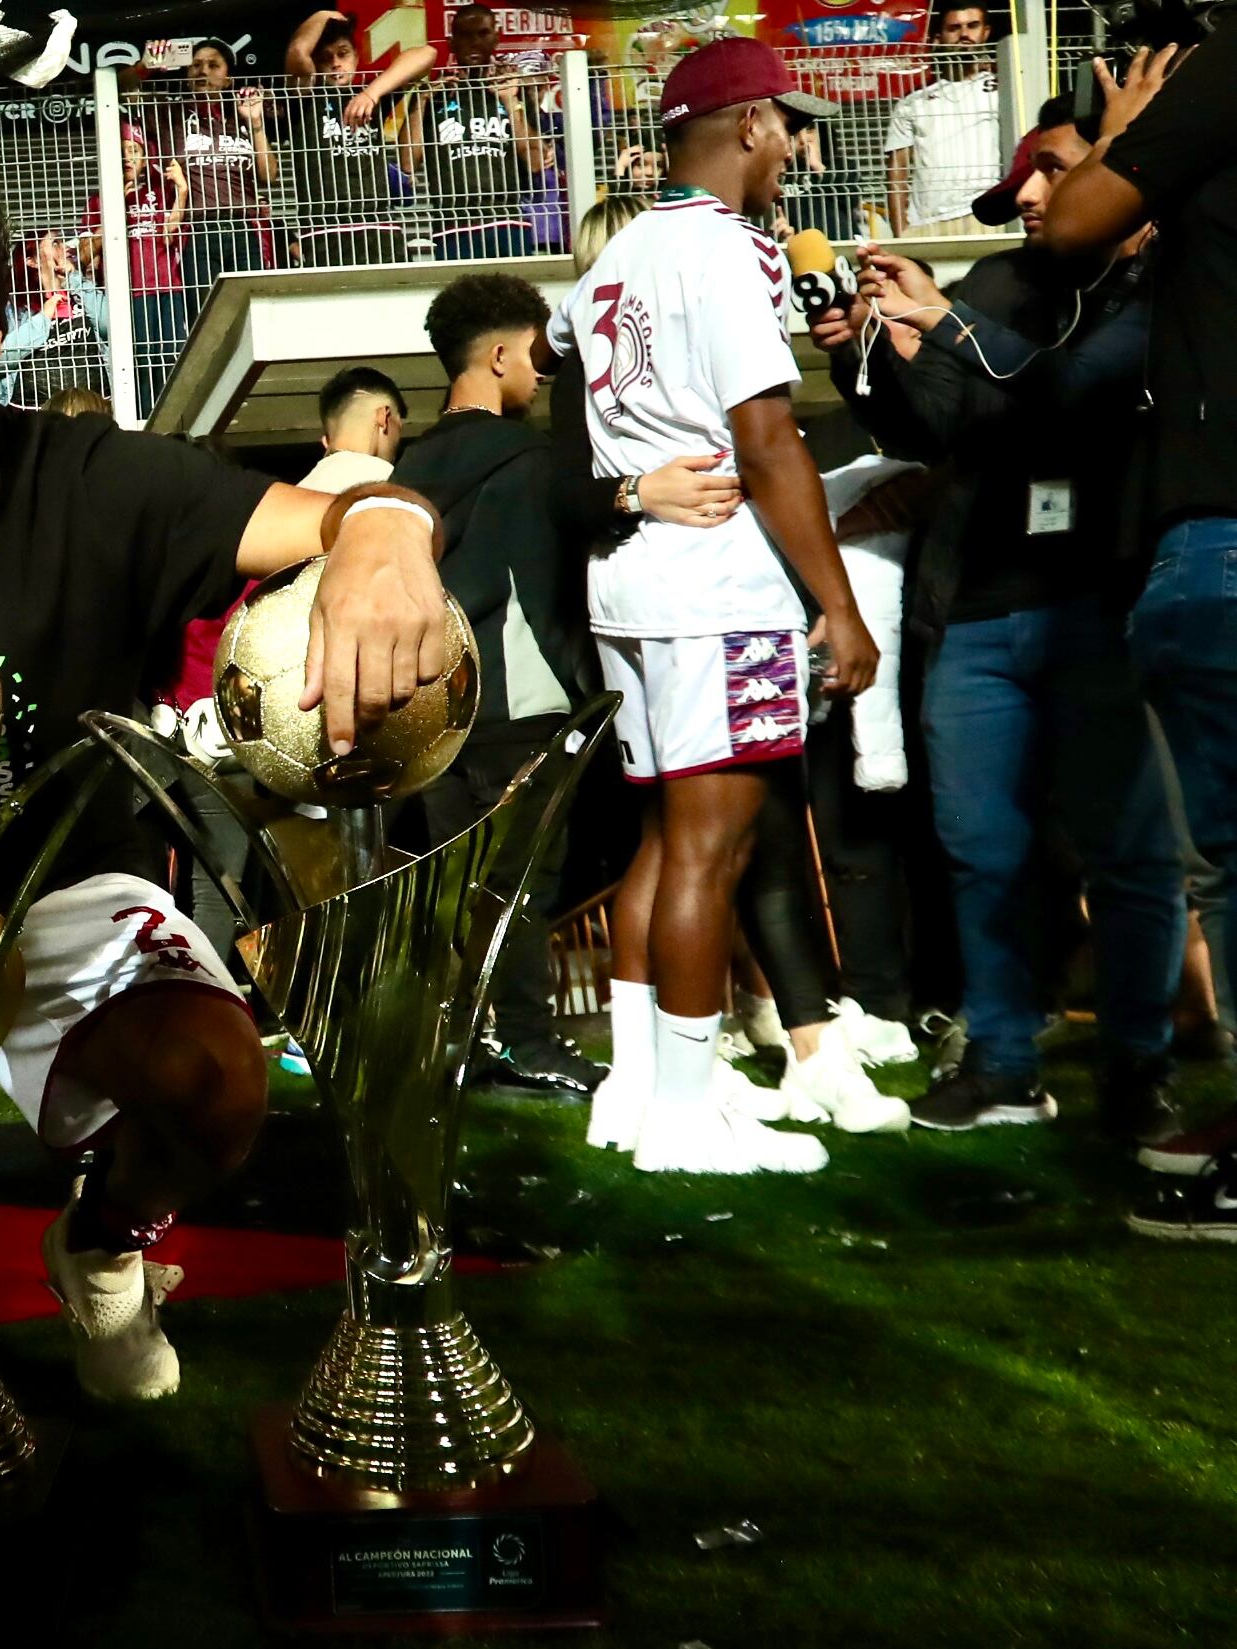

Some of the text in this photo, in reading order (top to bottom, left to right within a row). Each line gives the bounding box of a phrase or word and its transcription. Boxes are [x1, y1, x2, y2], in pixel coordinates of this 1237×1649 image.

[338, 1548, 474, 1562] AL CAMPEÓN NACIONAL
